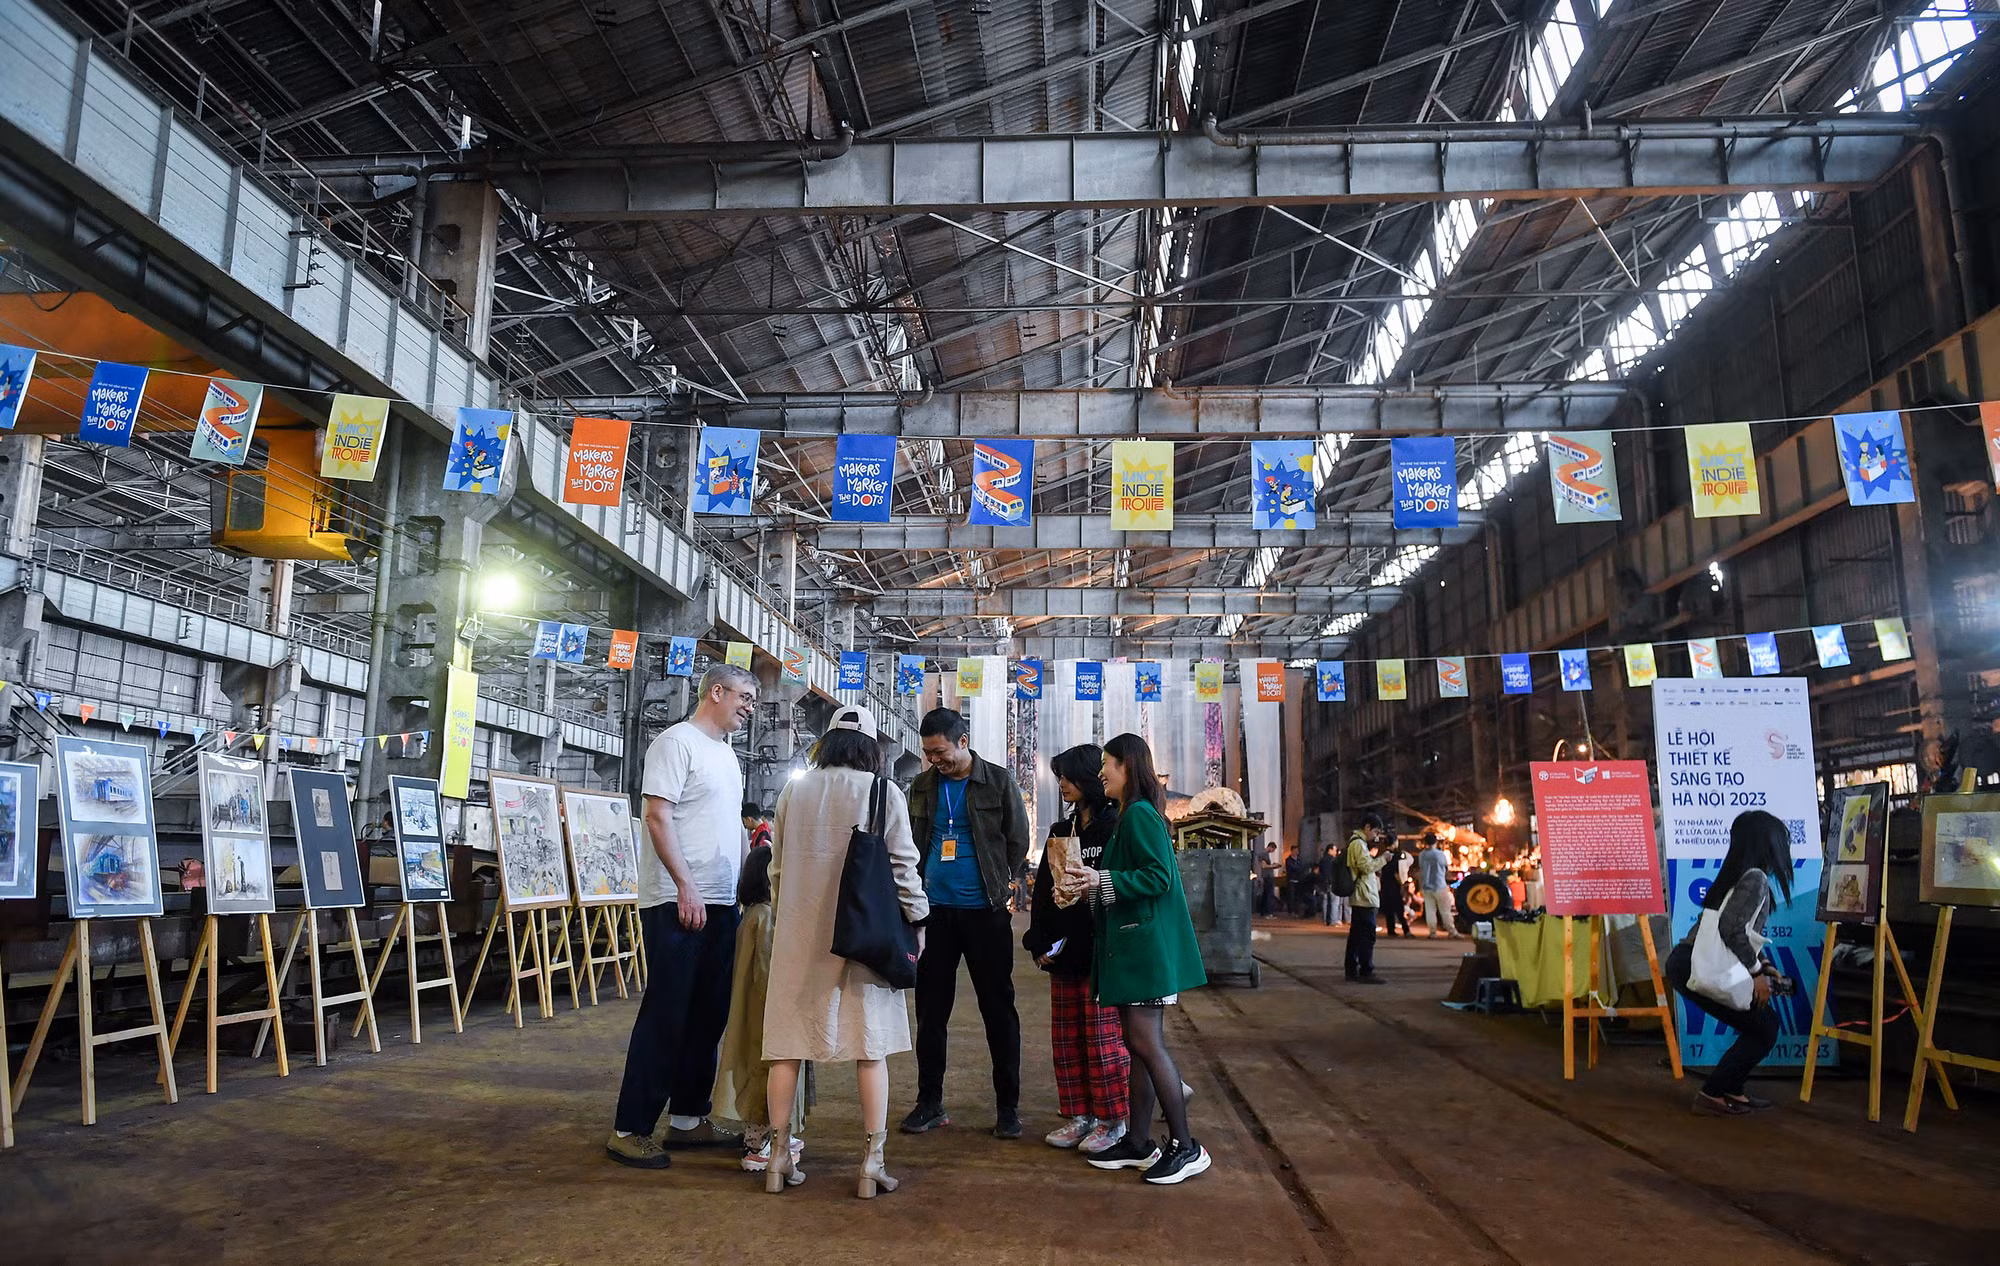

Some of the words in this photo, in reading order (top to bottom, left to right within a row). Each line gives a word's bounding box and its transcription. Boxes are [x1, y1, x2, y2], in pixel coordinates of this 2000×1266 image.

[1668, 728, 1683, 745] LỄ
[1688, 729, 1714, 747] HỘI
[1668, 747, 1708, 766] THIẾT
[1714, 747, 1733, 766] KẾ
[1716, 772, 1744, 788] TẠO
[1672, 790, 1693, 806] HÀ
[1698, 790, 1724, 807] NỘI
[1730, 792, 1766, 806] 2023
[1719, 828, 1730, 836] LÂ
[1698, 886, 1706, 898] 5
[1772, 926, 1792, 938] 3B2
[1690, 1044, 1704, 1058] 17
